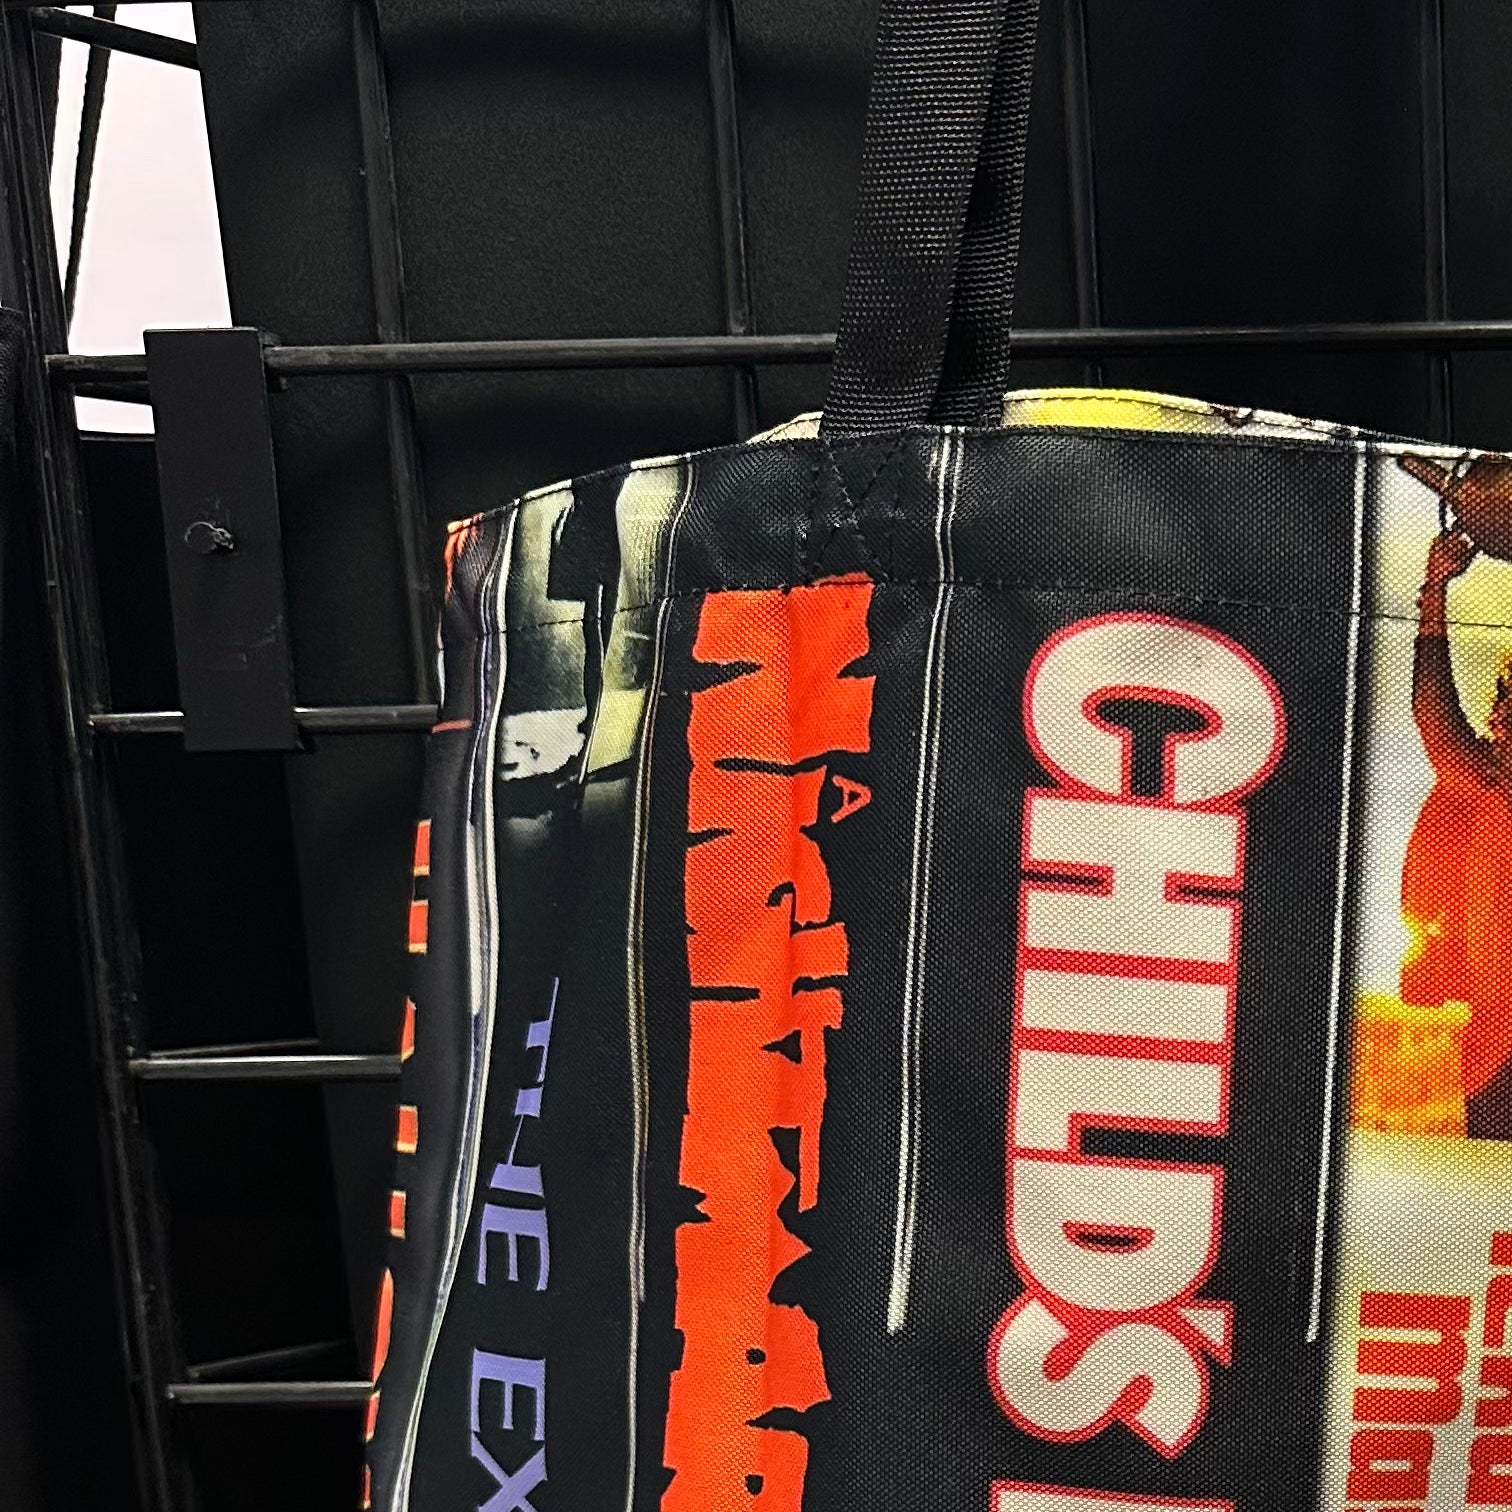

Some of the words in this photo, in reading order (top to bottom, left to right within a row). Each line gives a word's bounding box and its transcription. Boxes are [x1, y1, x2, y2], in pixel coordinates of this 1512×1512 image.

[829, 774, 872, 823] A
[476, 975, 560, 1292] THE
[985, 609, 1288, 1460] CHILD'S
